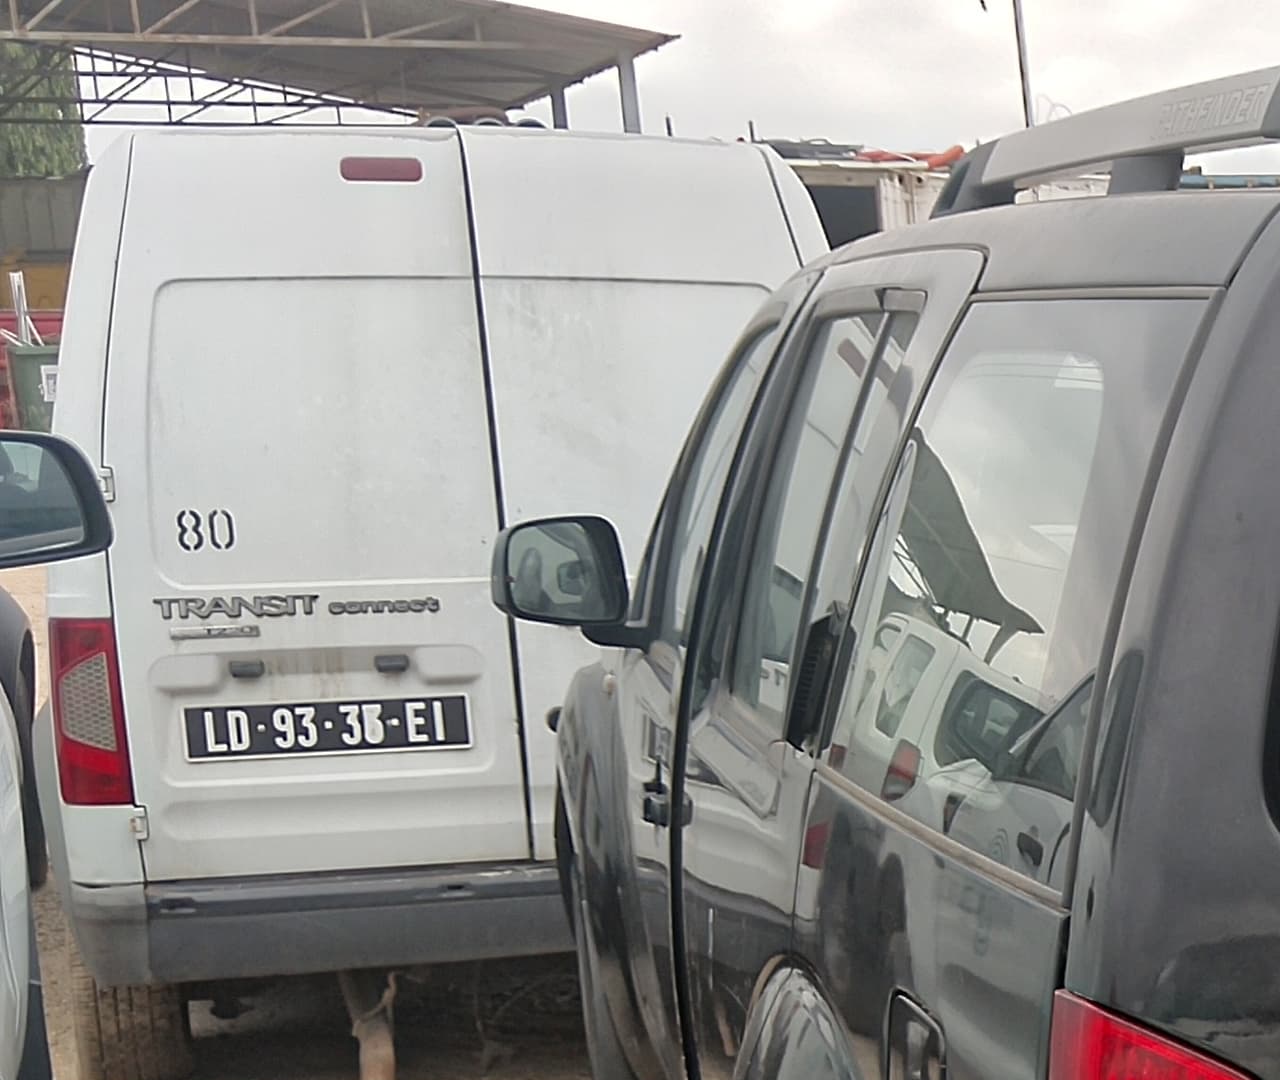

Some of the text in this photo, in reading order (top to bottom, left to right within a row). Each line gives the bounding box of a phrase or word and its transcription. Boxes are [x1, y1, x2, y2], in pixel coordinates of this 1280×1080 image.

[1151, 83, 1272, 140] ATHFINDER
[176, 509, 236, 551] 80
[153, 594, 440, 620] TRANSIT connect
